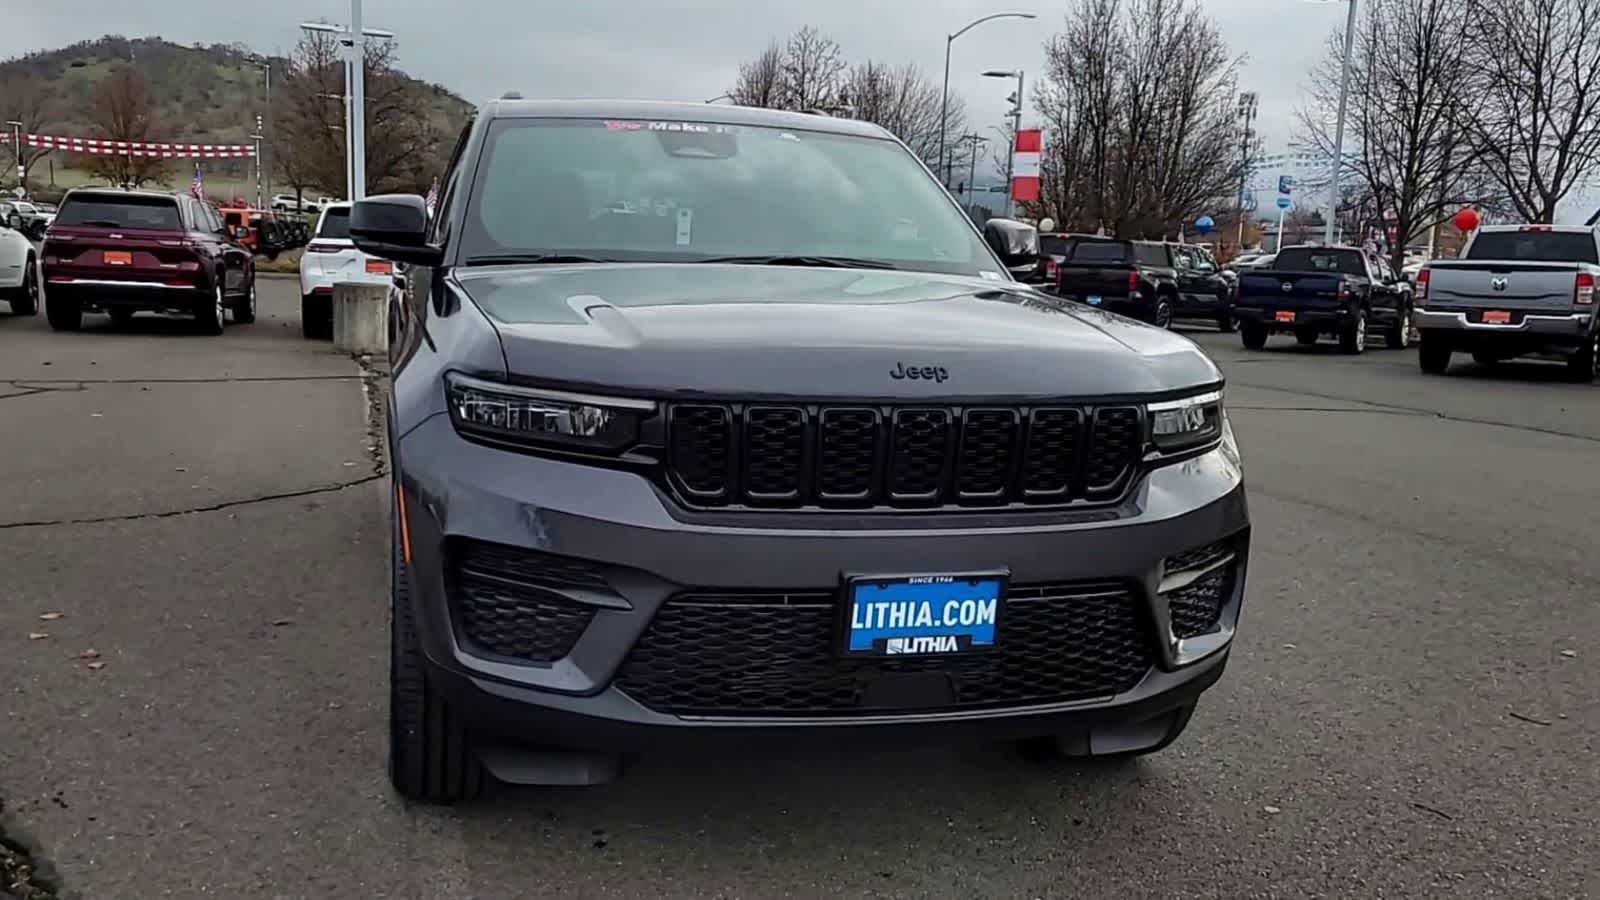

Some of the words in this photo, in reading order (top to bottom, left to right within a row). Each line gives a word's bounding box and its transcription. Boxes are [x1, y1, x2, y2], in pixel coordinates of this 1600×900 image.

[648, 121, 709, 132] Make
[889, 361, 950, 384] Jeep
[908, 576, 933, 584] SINCE
[851, 598, 997, 629] LITHIA.COM
[903, 636, 958, 654] LITHIA
